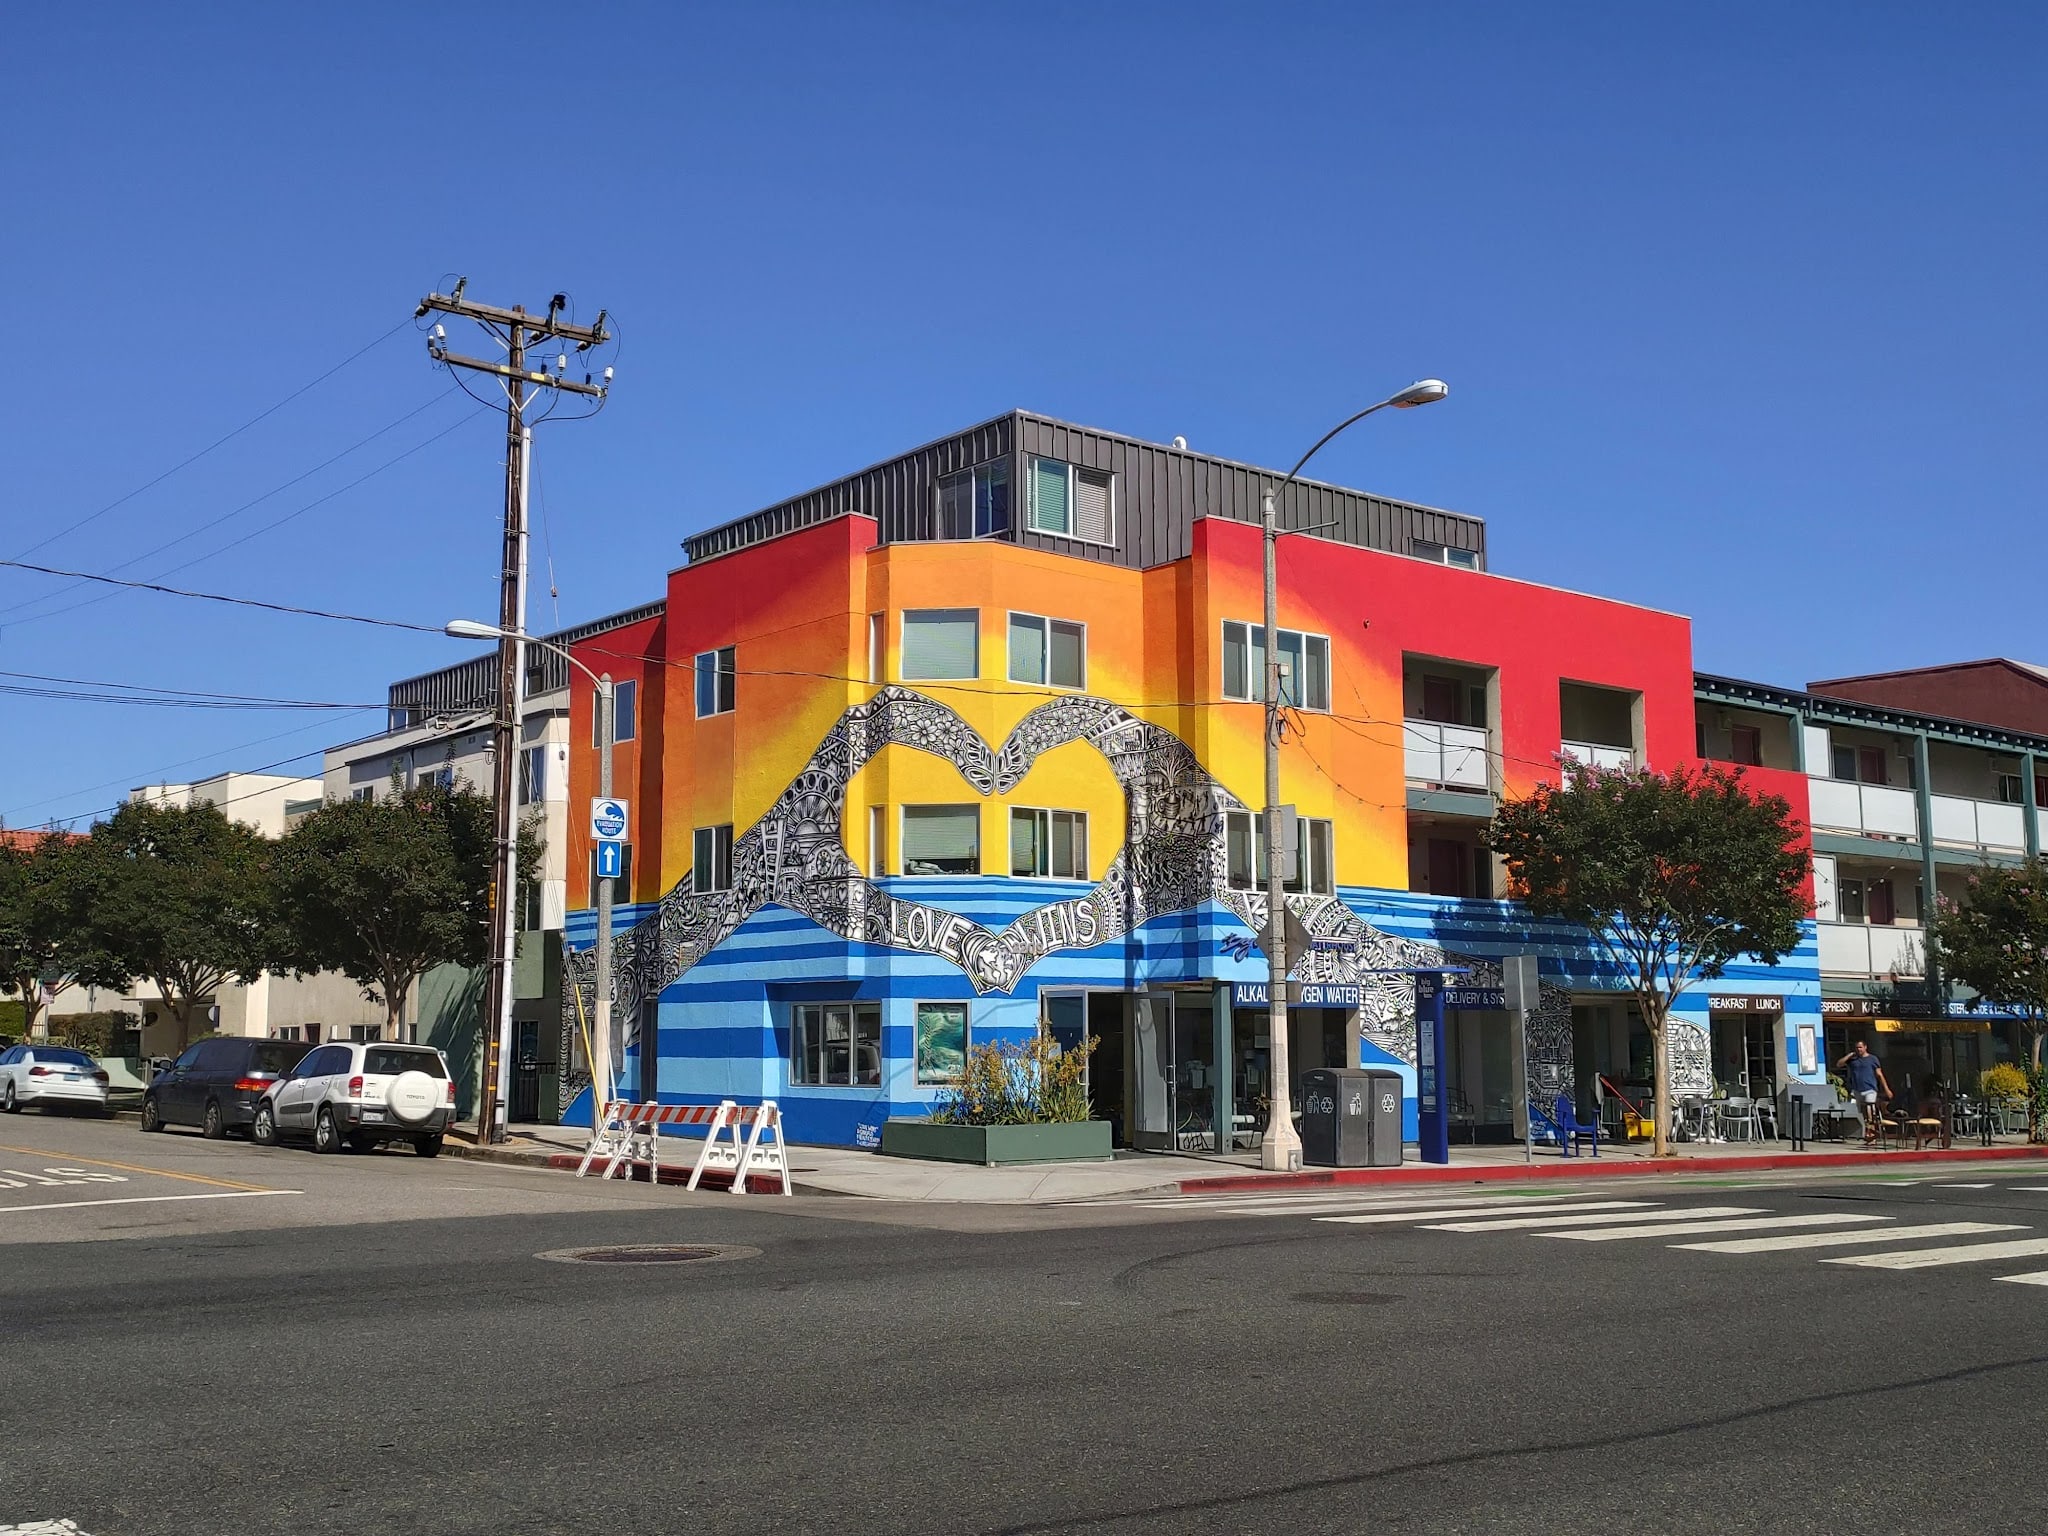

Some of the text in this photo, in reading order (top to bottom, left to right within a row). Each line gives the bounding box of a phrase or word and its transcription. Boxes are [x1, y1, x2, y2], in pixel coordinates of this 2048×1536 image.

[890, 900, 1096, 961] LOVE WINS
[1237, 985, 1359, 1004] ALKAL YGEN WATER
[1445, 991, 1505, 1006] DELIVERY & SYS
[1756, 999, 1781, 1010] LUNCH
